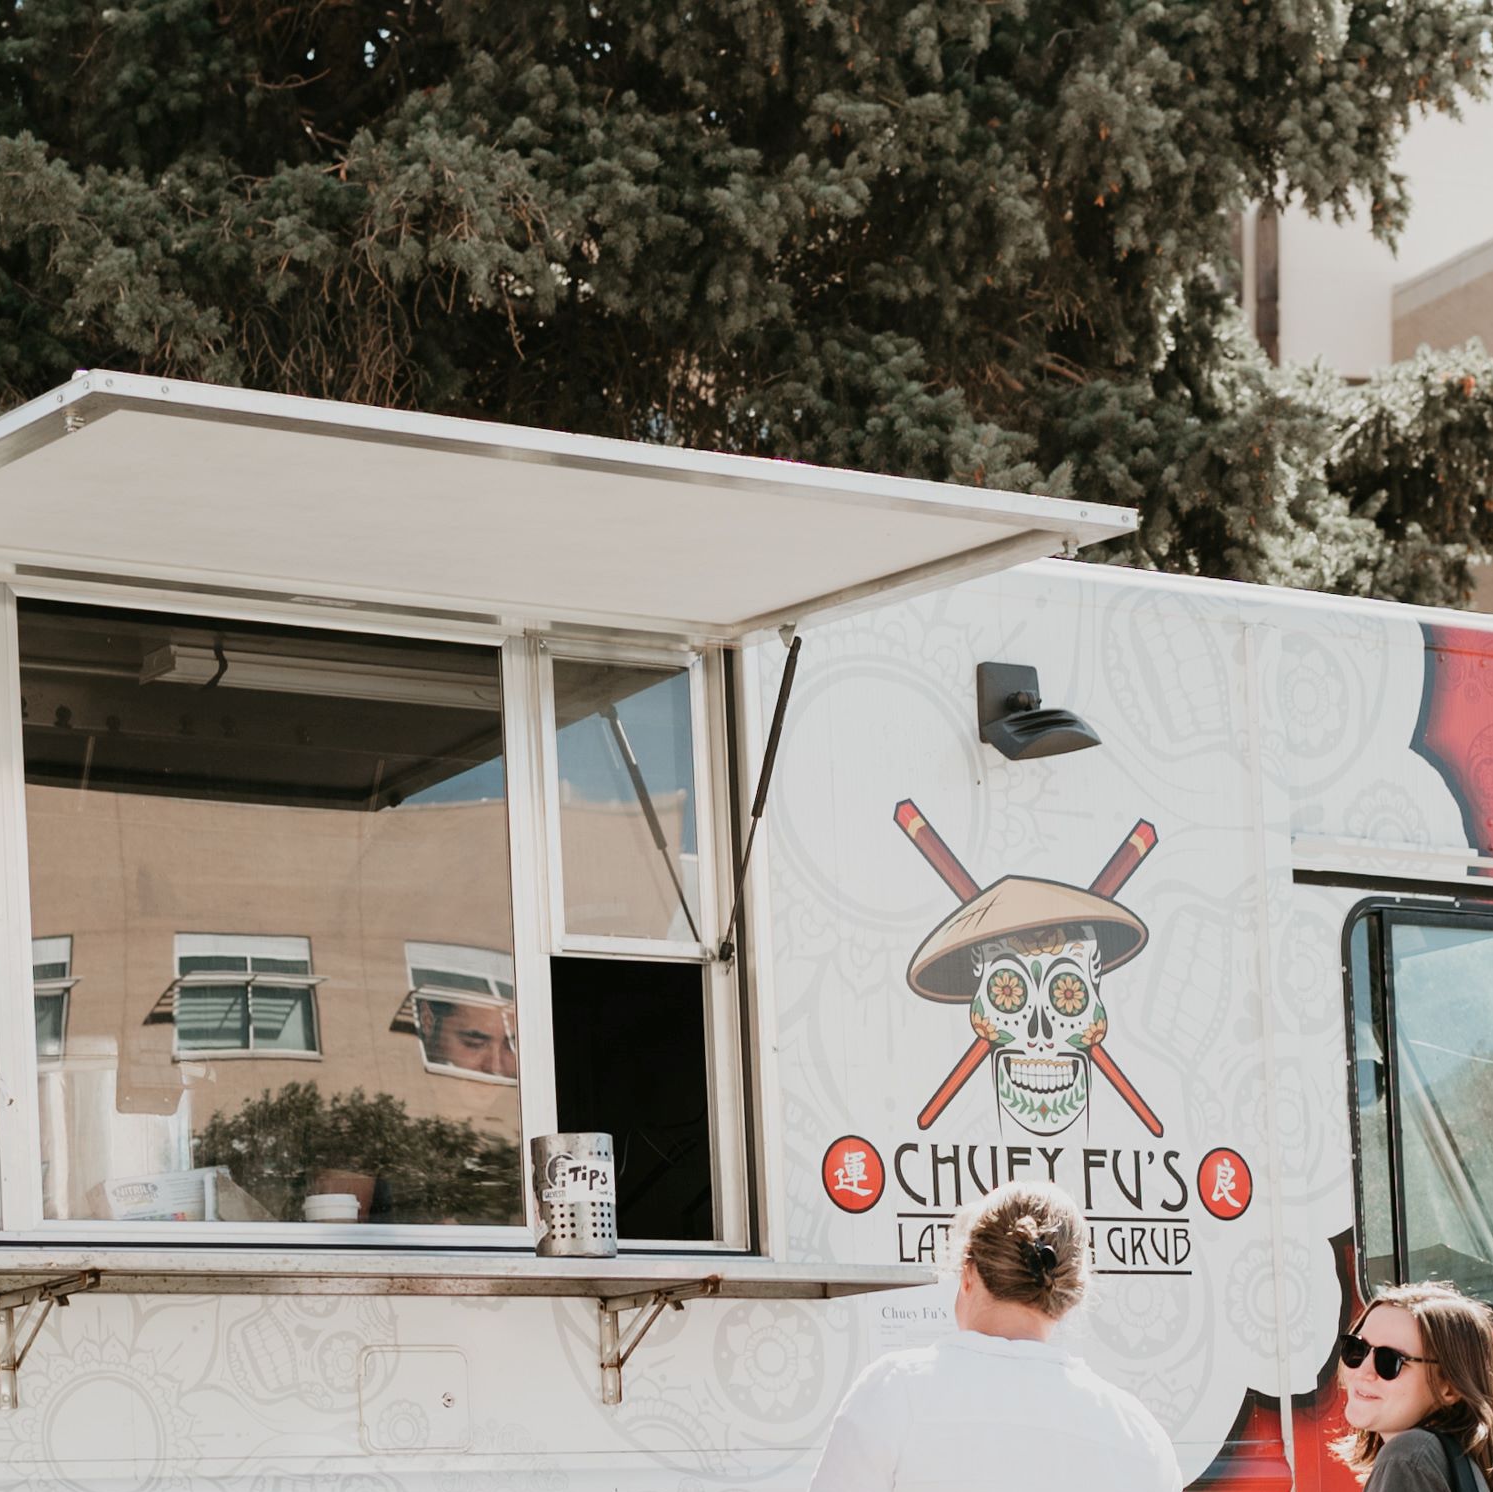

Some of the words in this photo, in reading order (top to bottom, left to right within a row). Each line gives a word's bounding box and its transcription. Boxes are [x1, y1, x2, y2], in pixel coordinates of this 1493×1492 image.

[568, 1165, 608, 1190] Tips
[834, 1152, 873, 1196] 運
[1082, 1148, 1189, 1212] FU'S
[1210, 1157, 1242, 1208] 良
[1107, 1226, 1192, 1266] GRUB
[881, 1306, 918, 1322] Chuey
[923, 1307, 947, 1319] Fu's
